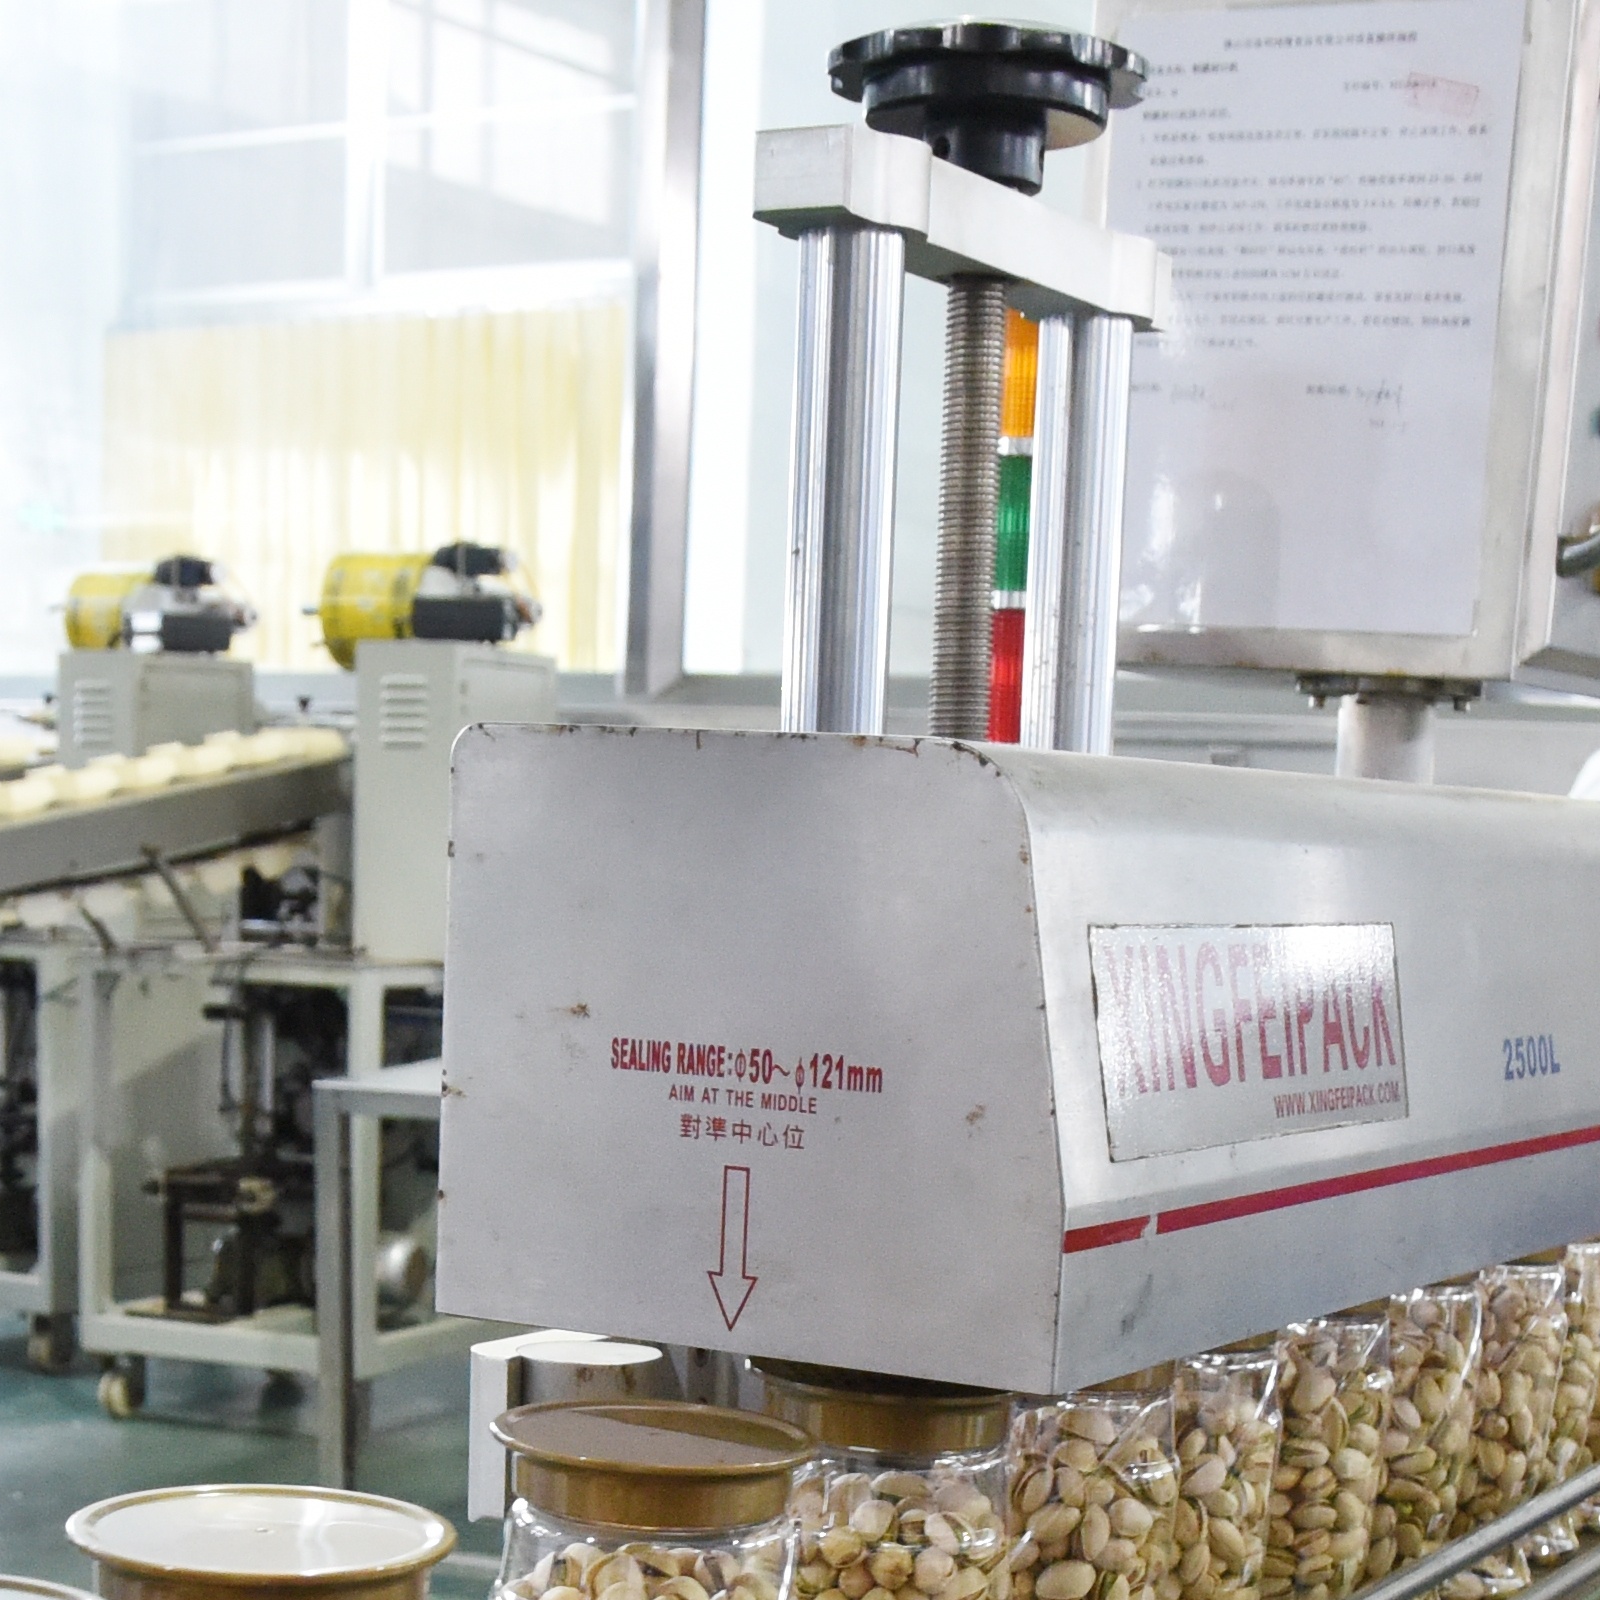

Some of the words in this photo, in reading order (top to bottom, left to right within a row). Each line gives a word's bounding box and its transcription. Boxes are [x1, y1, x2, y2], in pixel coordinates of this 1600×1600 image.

[610, 1036, 672, 1075] SEALING
[1502, 1034, 1560, 1081] 2500L
[668, 1083, 696, 1102] AIM
[701, 1086, 720, 1105] AT
[726, 1088, 754, 1109] THE
[760, 1093, 818, 1115] MIDDLE
[1273, 1081, 1401, 1119] WWW.XINGFEIPACK.COM
[679, 1112, 806, 1150] 對準中心位
